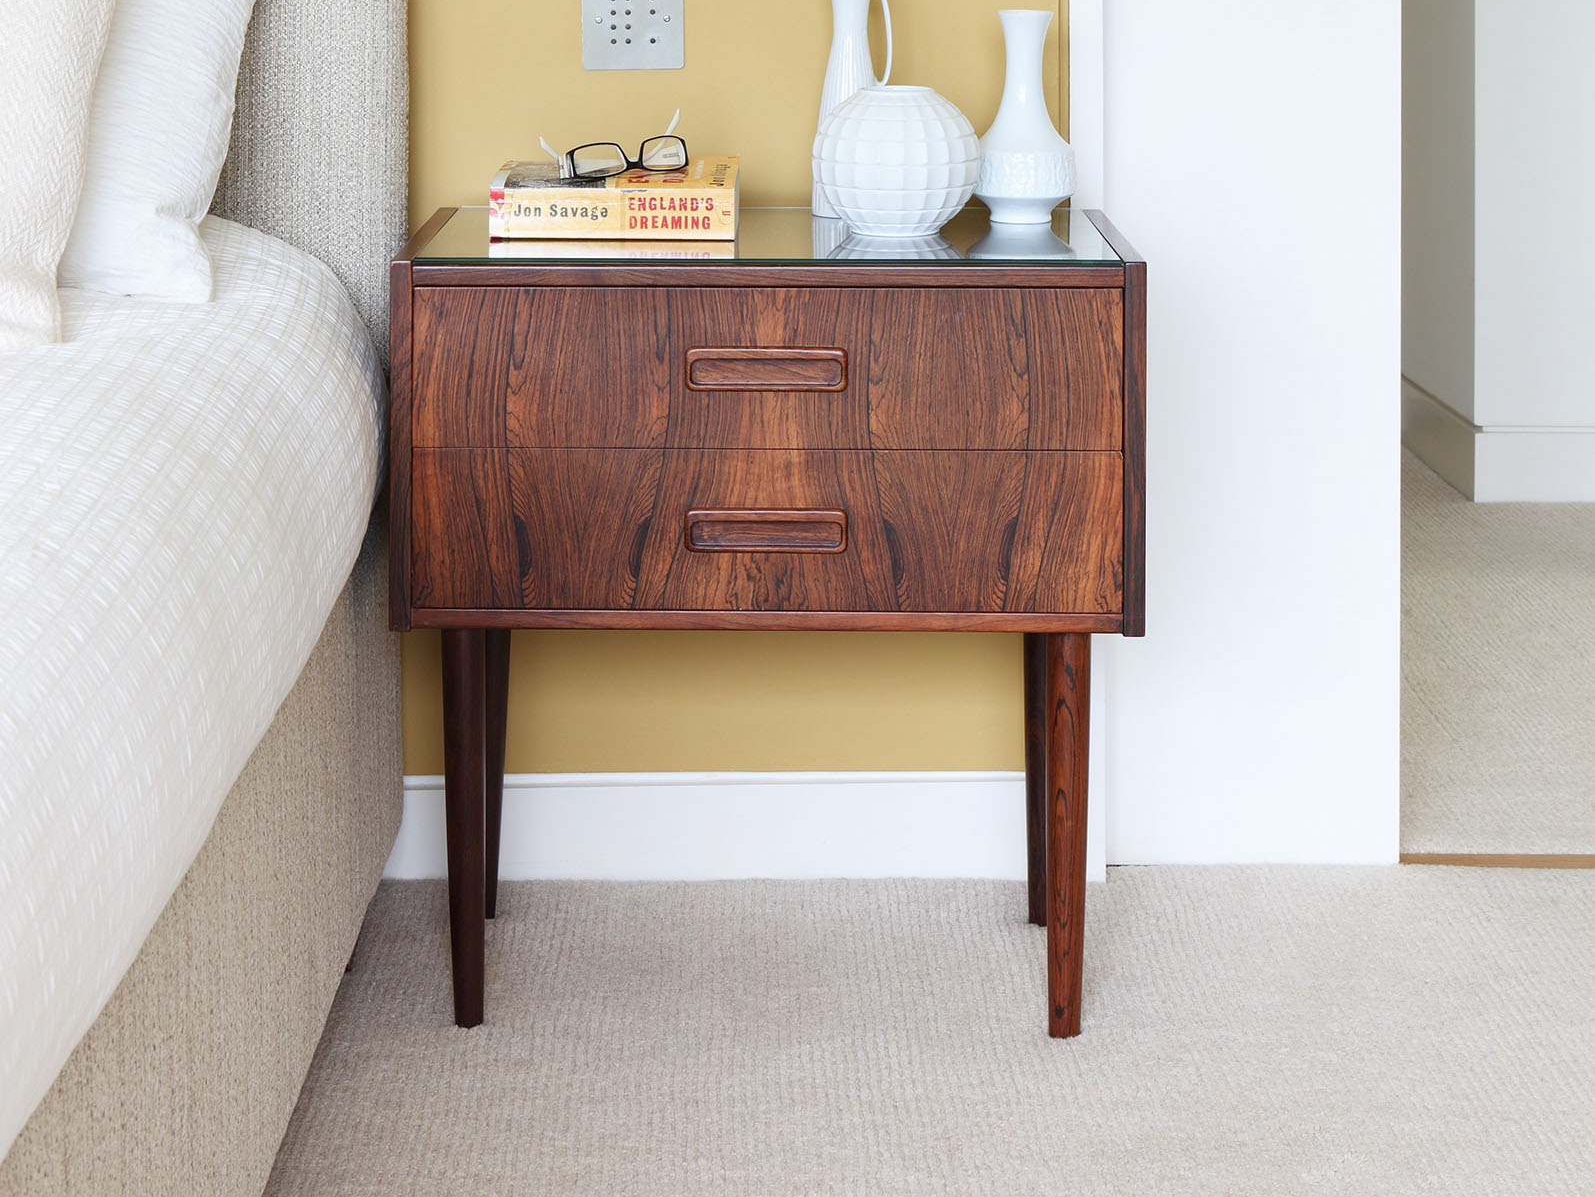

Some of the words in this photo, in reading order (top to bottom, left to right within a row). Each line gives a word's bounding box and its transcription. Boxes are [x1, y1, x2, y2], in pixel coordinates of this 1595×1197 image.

[514, 203, 542, 217] Jon
[549, 203, 609, 221] Savage
[628, 197, 715, 212] ENGLAND'S
[628, 215, 711, 230] DREAMING
